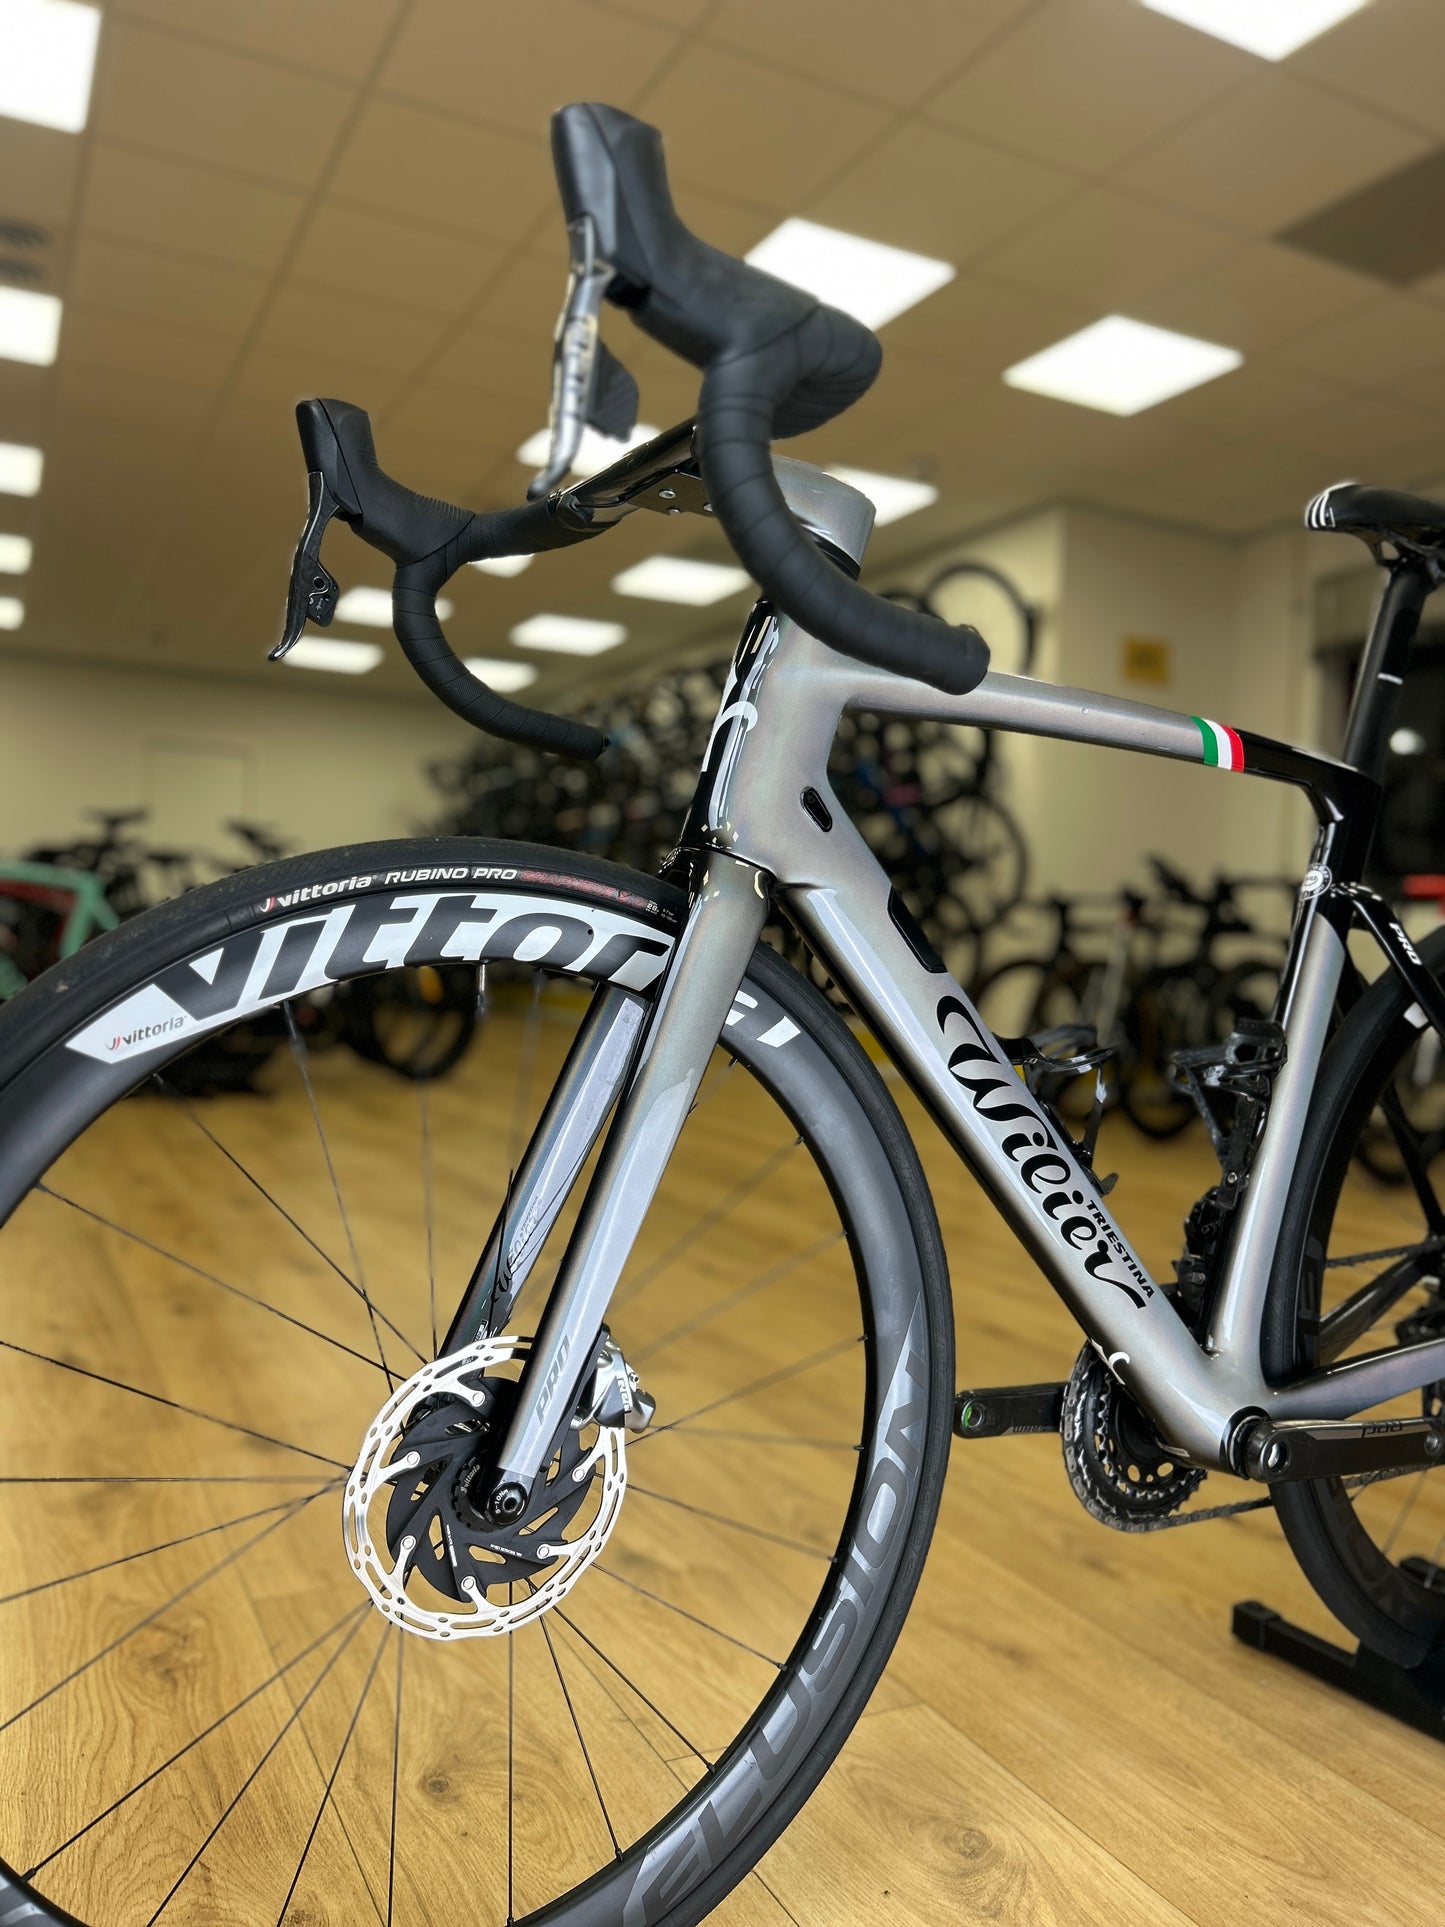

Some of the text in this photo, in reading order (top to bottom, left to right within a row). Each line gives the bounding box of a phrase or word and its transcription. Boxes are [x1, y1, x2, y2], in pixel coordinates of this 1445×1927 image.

[277, 876, 372, 907] vittoria
[384, 867, 469, 885] RUBINO
[472, 867, 518, 881] PRO
[1388, 922, 1422, 966] PRO
[122, 1016, 184, 1045] vittoria
[936, 996, 1146, 1309] Wilier
[1086, 1200, 1154, 1298] TRIESTINA
[640, 1350, 927, 1926] ELUSION
